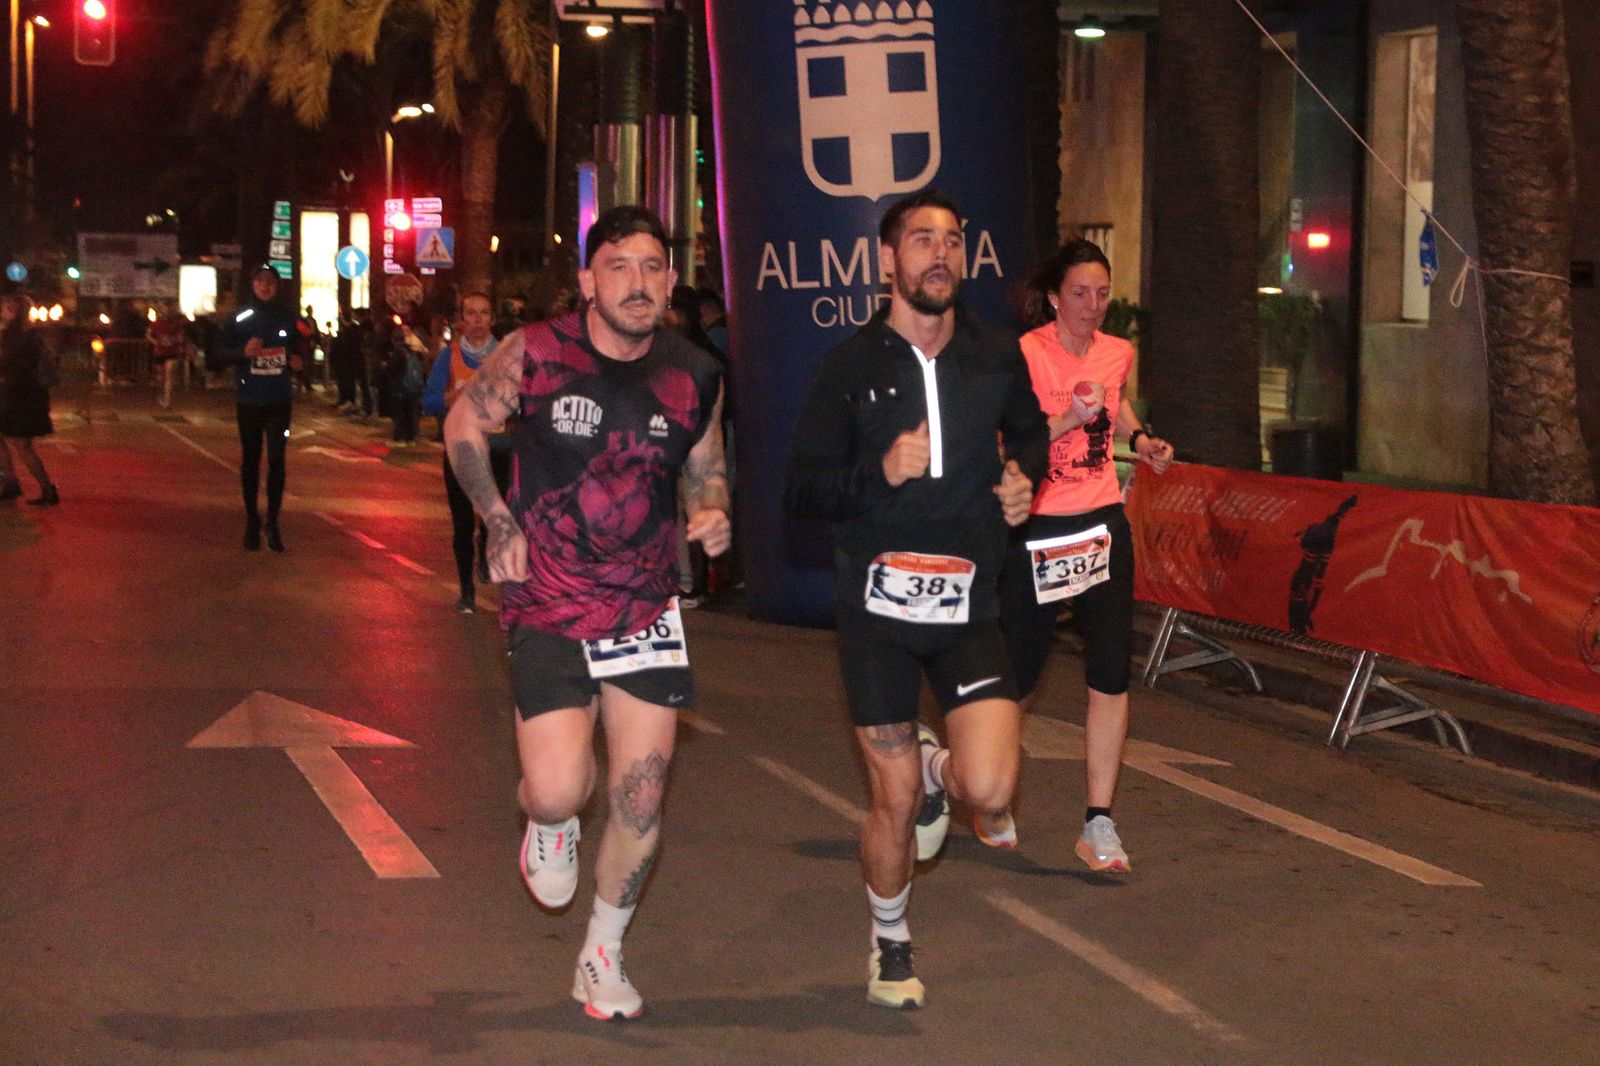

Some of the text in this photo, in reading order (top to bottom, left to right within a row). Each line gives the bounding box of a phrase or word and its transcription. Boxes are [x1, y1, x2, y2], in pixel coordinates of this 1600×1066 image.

[757, 217, 1004, 292] ALMÍA
[1055, 552, 1101, 579] 387
[905, 576, 947, 597] 38
